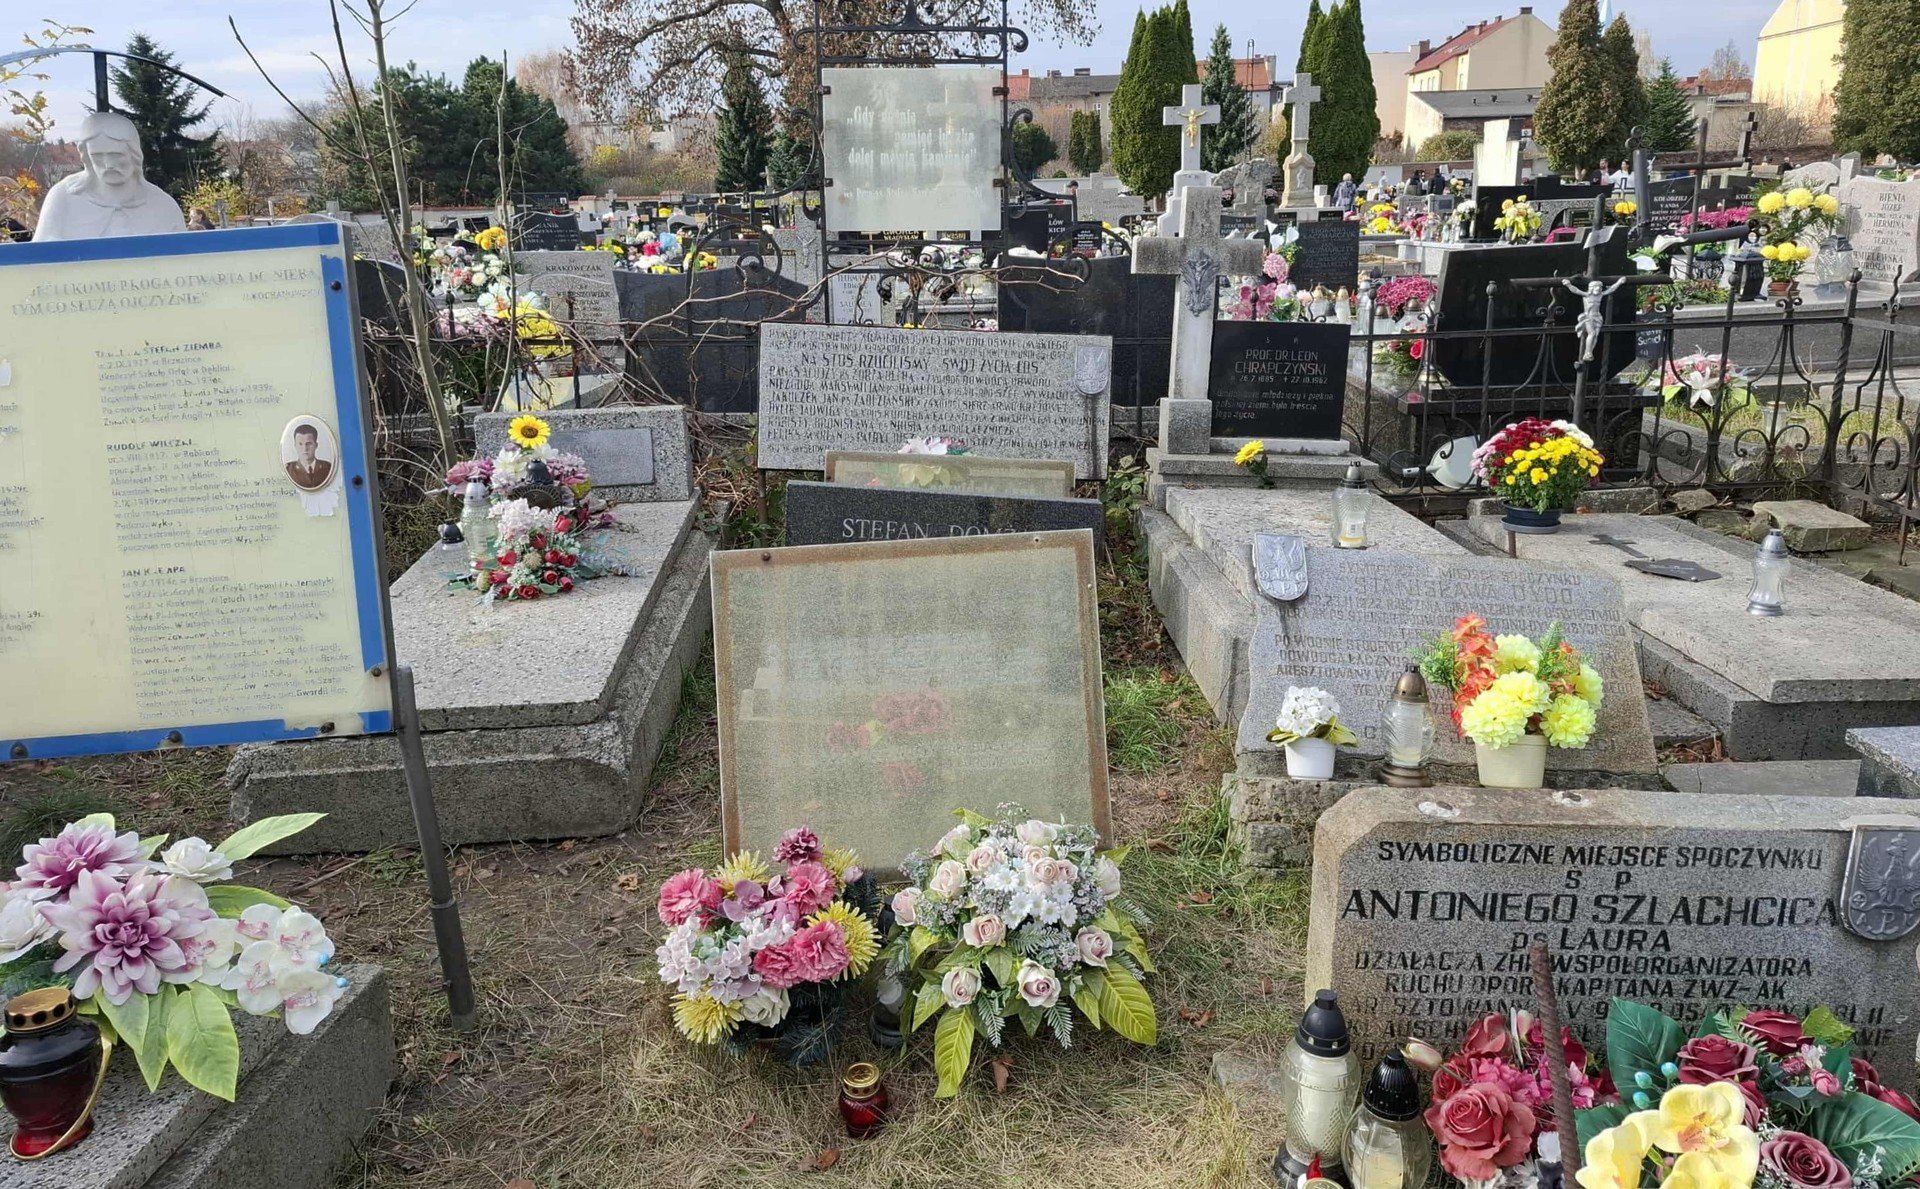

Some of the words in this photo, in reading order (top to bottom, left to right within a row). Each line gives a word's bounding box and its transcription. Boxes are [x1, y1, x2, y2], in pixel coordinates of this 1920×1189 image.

[545, 264, 602, 272] KRAKOWCZAK
[801, 353, 817, 367] NA
[1275, 349, 1289, 361] DR
[1291, 350, 1319, 361] LEON
[842, 517, 931, 541] STEFAN
[1276, 664, 1372, 680] ARESZTOWANY
[1378, 841, 1555, 865] SYMBOLICZNE
[1562, 845, 1669, 868] MIEJSCE
[1675, 847, 1823, 870] SPOCZYNKU
[1615, 871, 1632, 891] P
[1341, 889, 1579, 923] ANTONIEGO
[1591, 894, 1841, 928] SZLACHCICA
[1559, 928, 1673, 952] LAURA
[1354, 951, 1484, 972] DZIAŁACZA
[1383, 972, 1464, 995] RUCHU
[1555, 976, 1675, 998] KAPITANA
